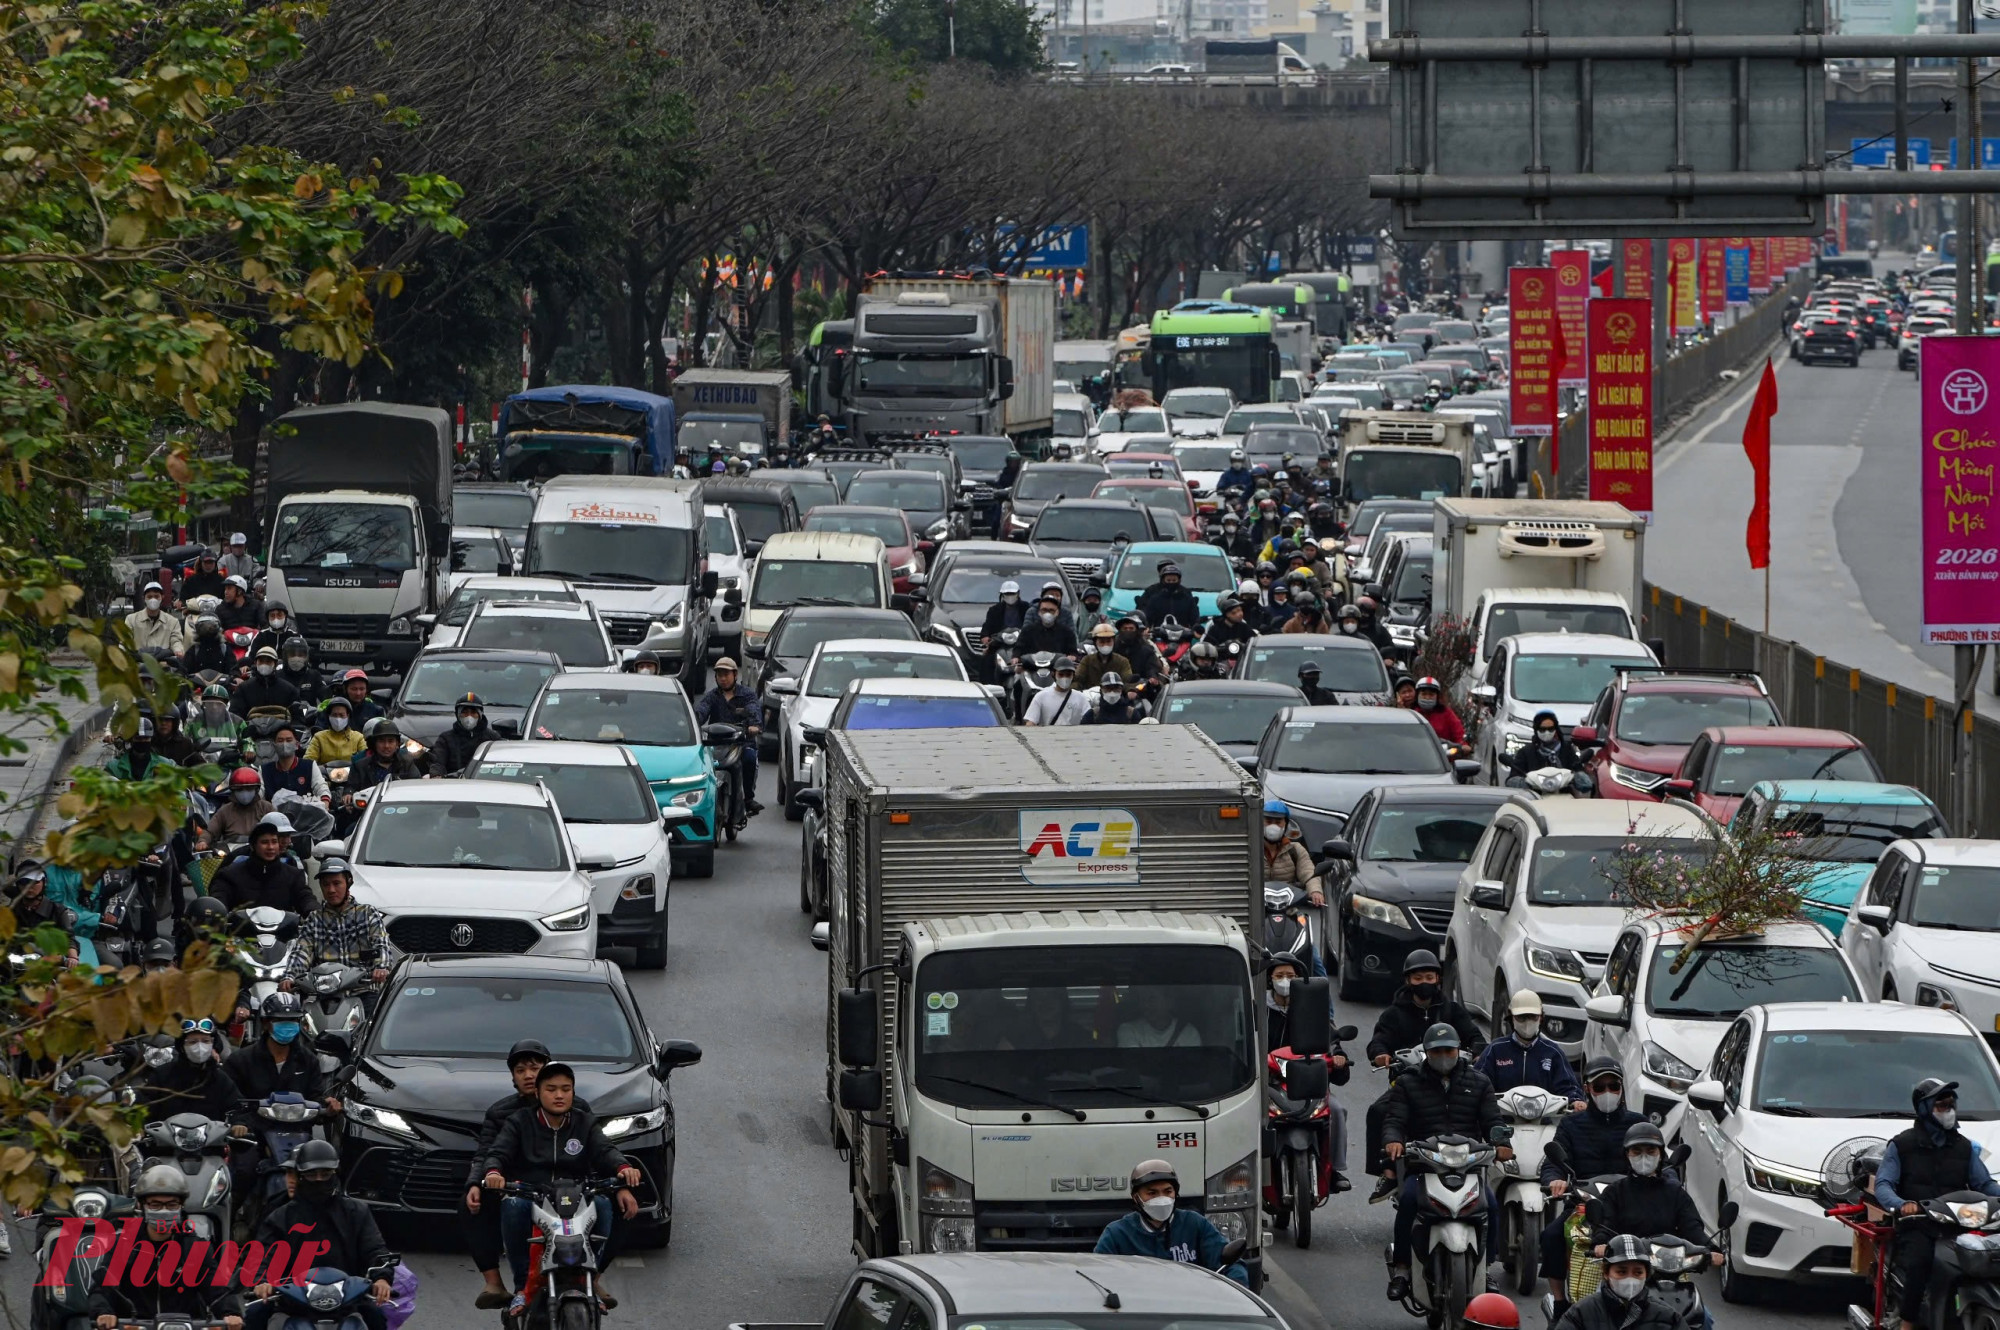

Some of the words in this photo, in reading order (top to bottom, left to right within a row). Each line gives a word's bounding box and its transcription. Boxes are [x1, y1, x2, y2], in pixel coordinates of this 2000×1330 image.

[1932, 428, 1997, 451] Chúc
[1939, 455, 1994, 496] Mừng
[571, 506, 658, 521] Redsun
[1948, 510, 1986, 536] Mới
[1936, 548, 1999, 565] 2026
[325, 578, 361, 587] ISUZU
[1930, 628, 1968, 641] PHƯỜNG
[1971, 628, 1989, 641] YÊN
[1027, 822, 1133, 857] ACE
[1077, 862, 1128, 873] Express
[453, 925, 472, 945] MG
[1157, 1132, 1196, 1140] QKR
[1157, 1140, 1198, 1148] 210
[1051, 1176, 1128, 1192] ISUZU
